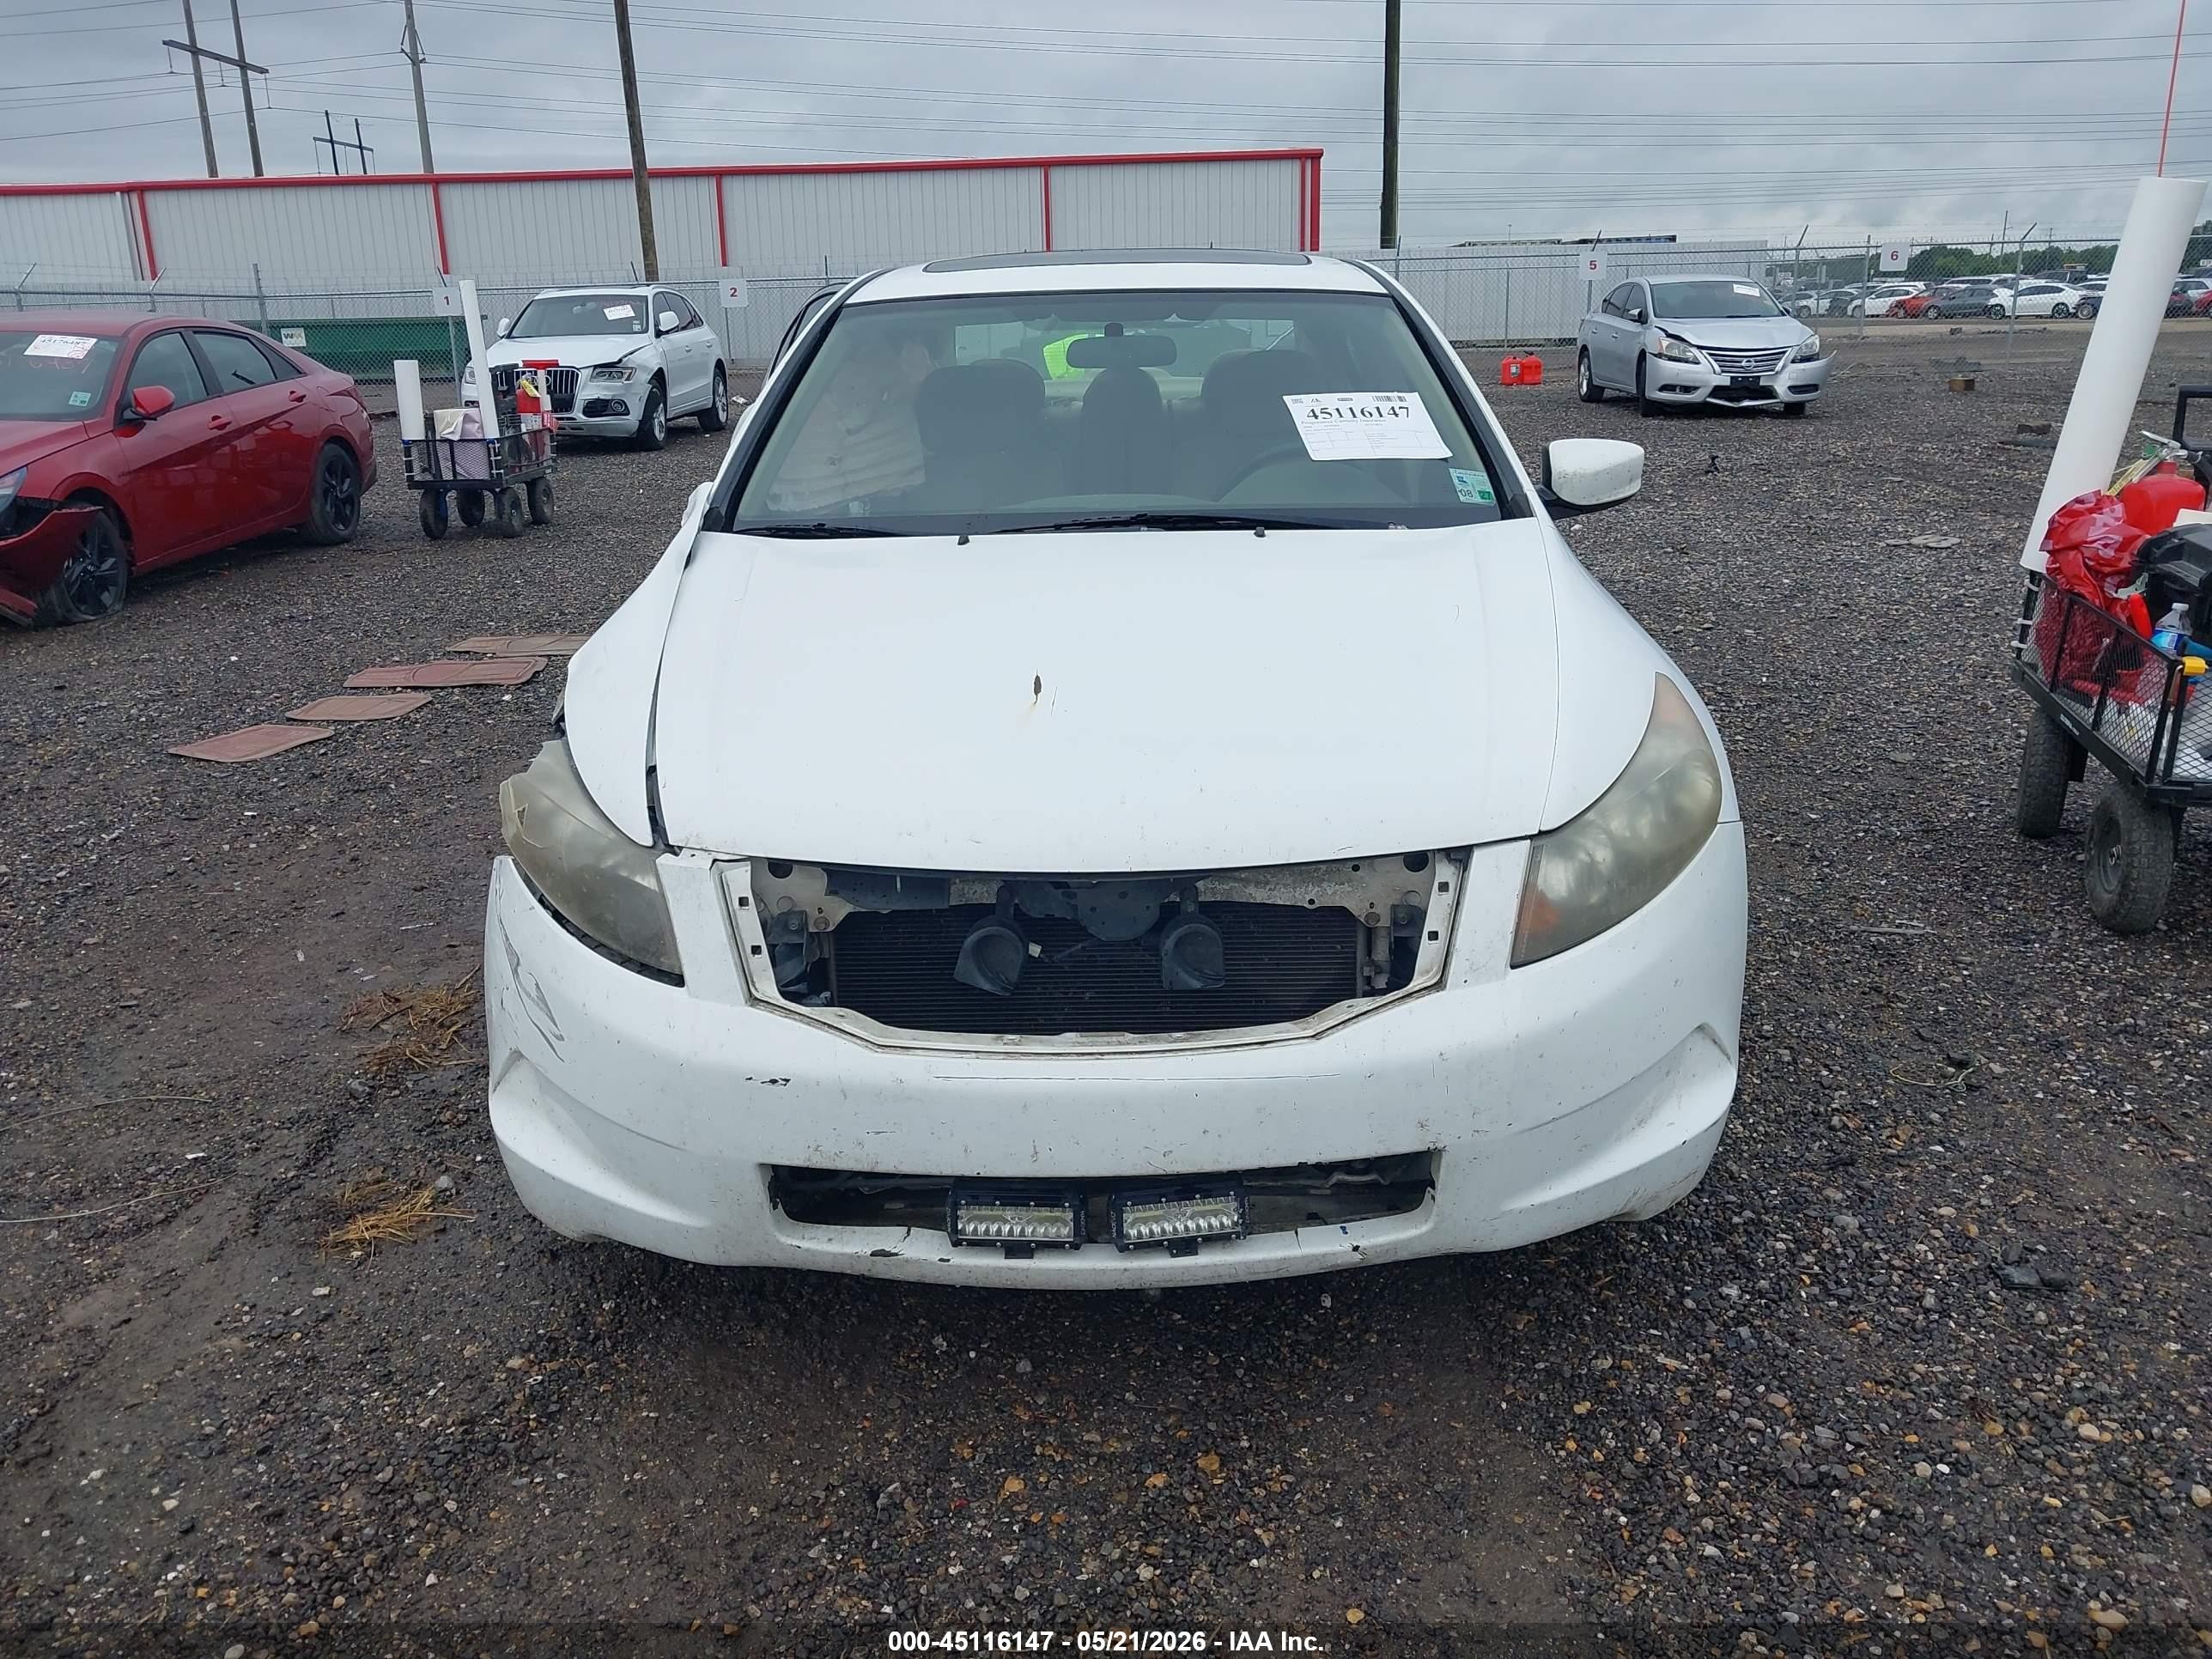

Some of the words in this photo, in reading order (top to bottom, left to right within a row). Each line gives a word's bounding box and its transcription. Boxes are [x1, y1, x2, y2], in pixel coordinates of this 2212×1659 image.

[1890, 250, 1899, 261] 6
[1589, 259, 1597, 270] 5
[729, 287, 738, 298] 2
[443, 295, 450, 306] 1
[1306, 405, 1410, 420] 45116147
